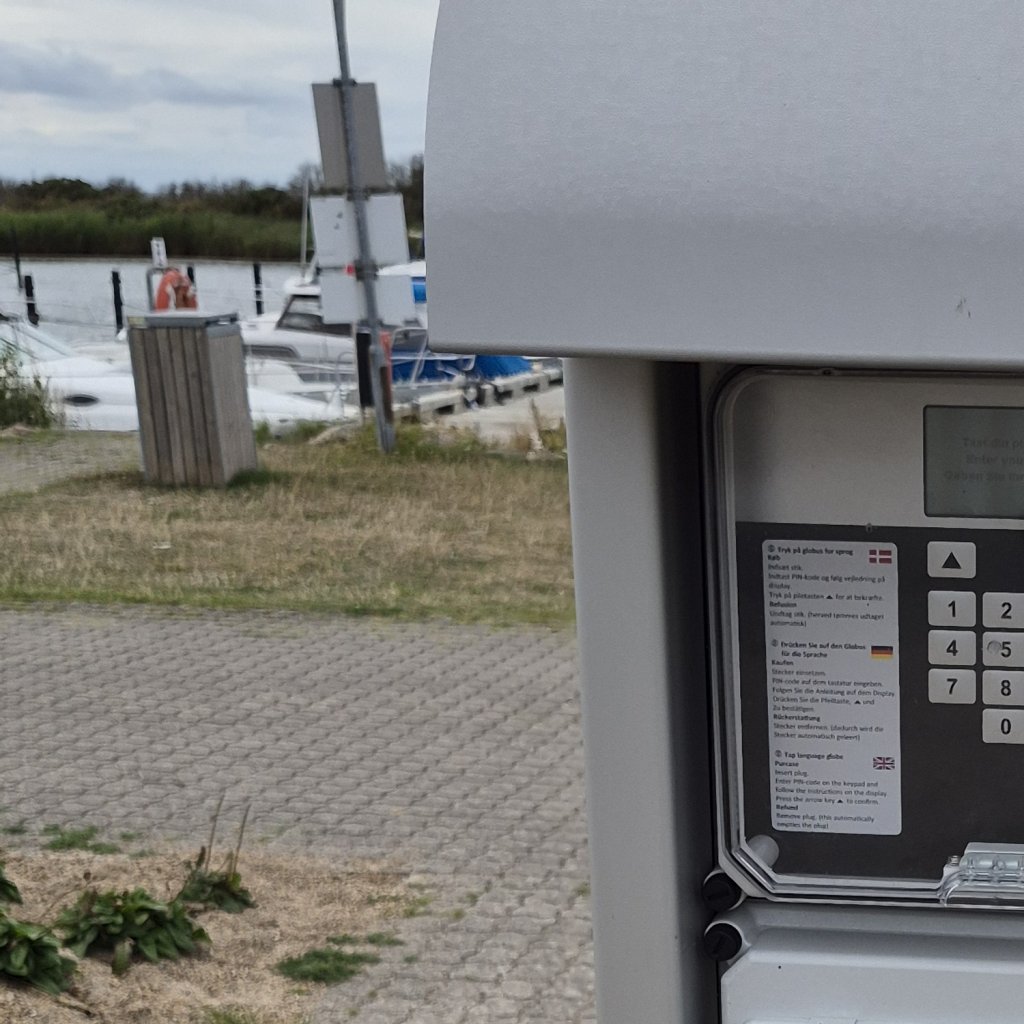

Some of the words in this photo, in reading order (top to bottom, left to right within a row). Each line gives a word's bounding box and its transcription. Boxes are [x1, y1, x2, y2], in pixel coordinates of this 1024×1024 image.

[802, 547, 823, 555] globus
[948, 601, 956, 617] 1
[1001, 602, 1012, 619] 2
[946, 640, 958, 656] 4
[1001, 642, 1011, 658] 5
[947, 678, 958, 694] 7
[1001, 680, 1011, 696] 8
[1001, 718, 1011, 734] 0
